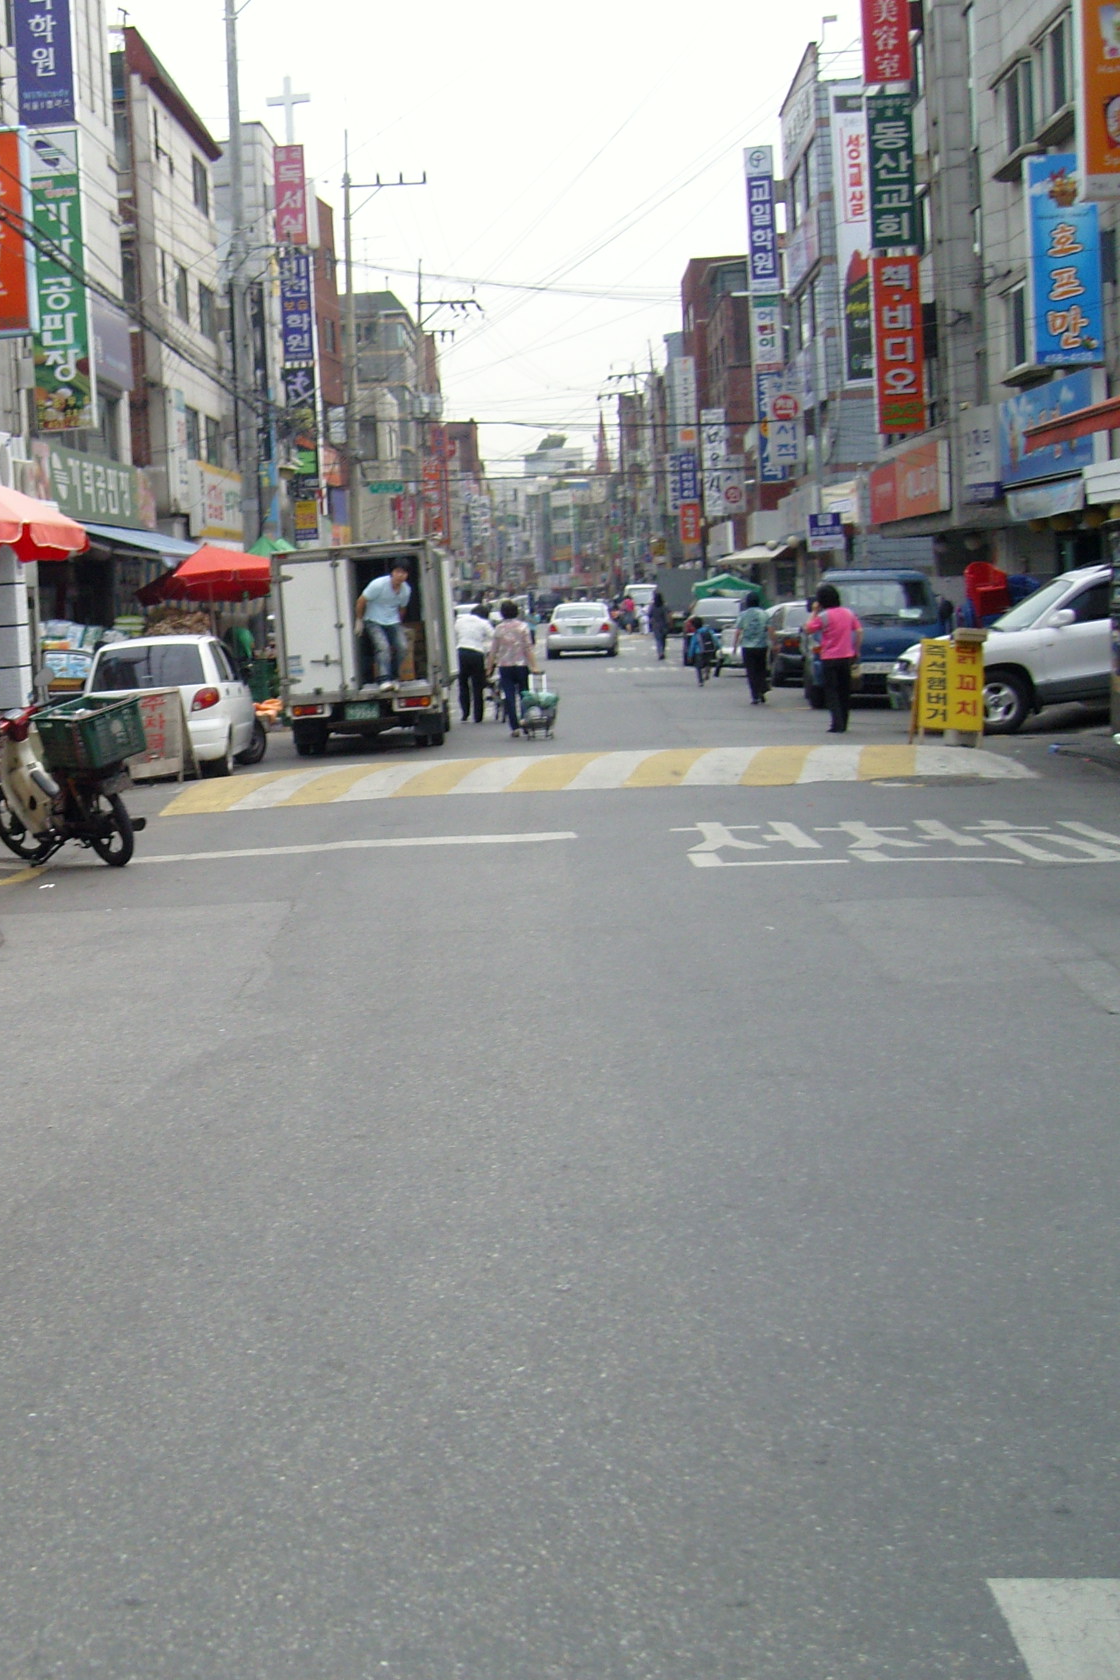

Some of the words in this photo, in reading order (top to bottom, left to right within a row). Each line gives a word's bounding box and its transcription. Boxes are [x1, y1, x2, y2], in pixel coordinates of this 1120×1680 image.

[279, 164, 304, 234] 독서실
[871, 121, 913, 240] 동산교회
[34, 201, 80, 383] 가락공판장
[1046, 222, 1090, 350] 호프만
[285, 313, 311, 352] 학원
[66, 456, 131, 518] 가락공판장
[669, 818, 1120, 869] 천천히
